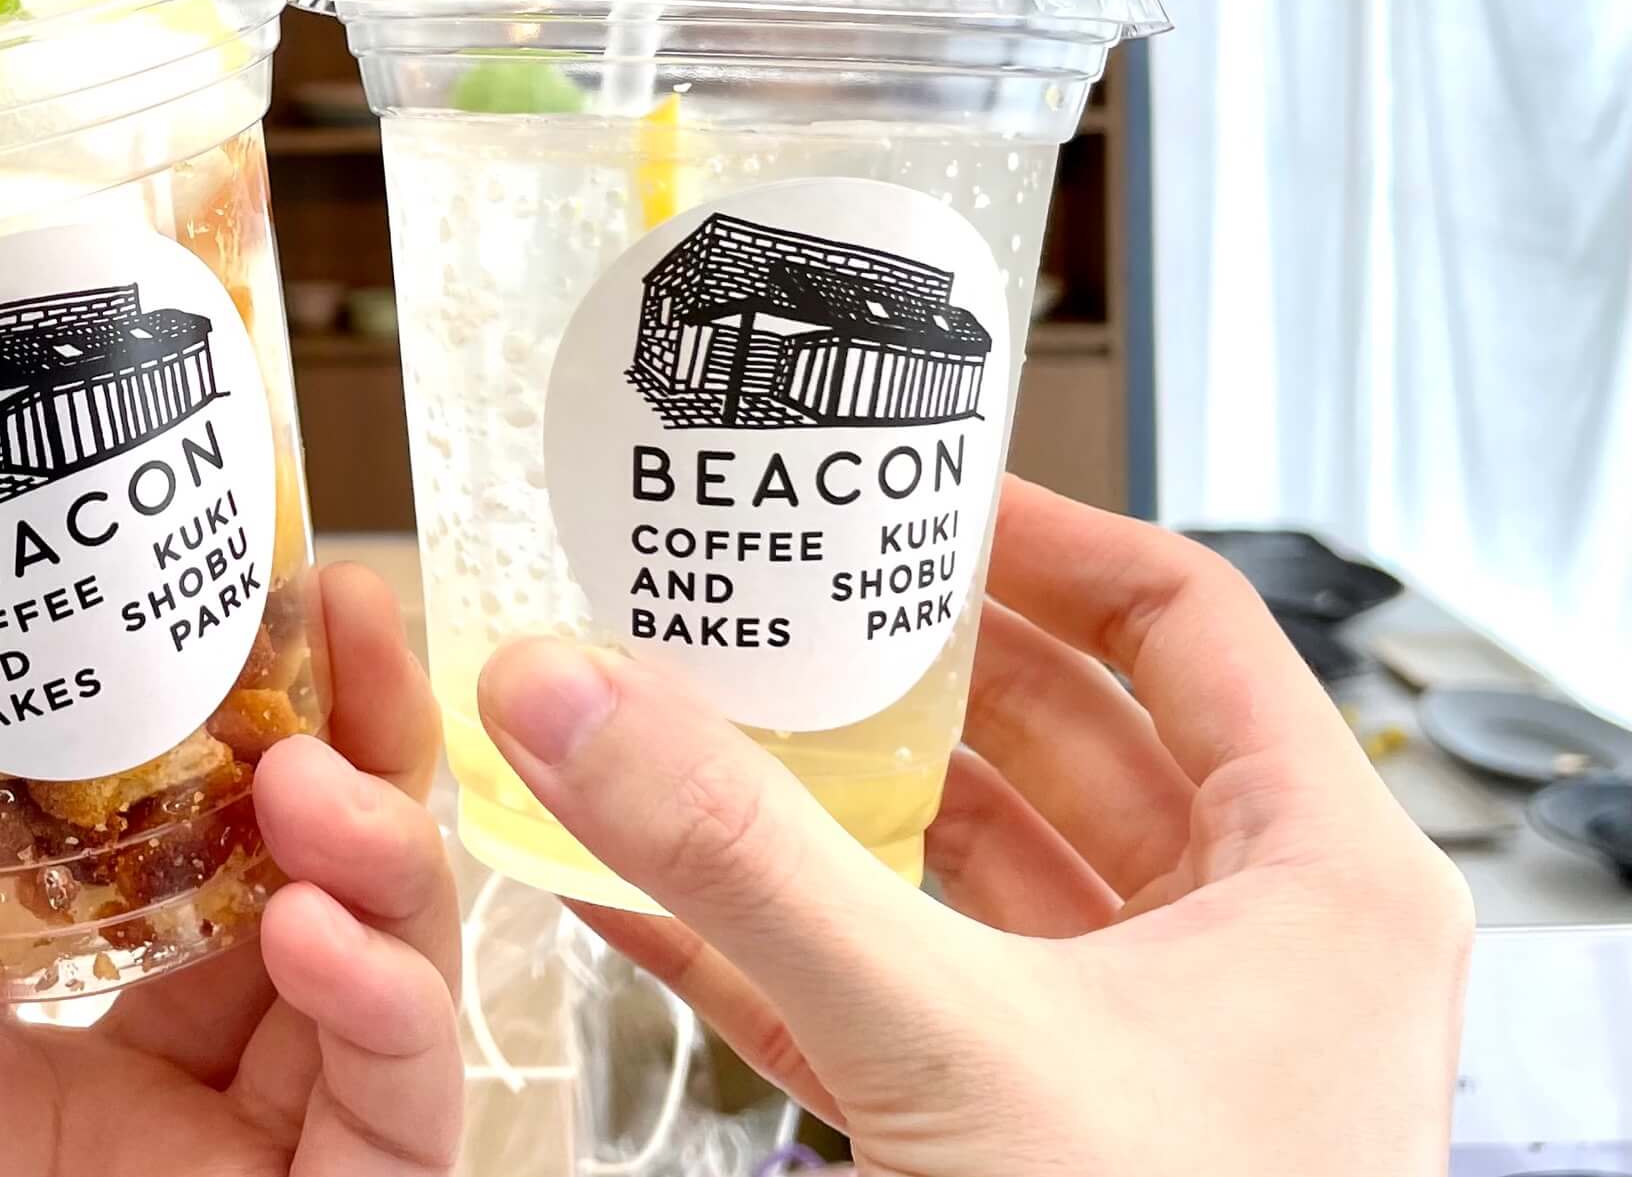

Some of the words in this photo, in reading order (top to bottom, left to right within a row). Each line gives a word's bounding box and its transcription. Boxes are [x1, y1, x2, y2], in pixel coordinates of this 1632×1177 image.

[632, 434, 964, 508] BEACON
[153, 489, 238, 571] KUKI
[631, 524, 824, 562] COFFEE
[881, 510, 958, 555] KUKI
[121, 526, 247, 632] SHOBU
[630, 566, 734, 604] AND
[831, 551, 955, 602] SHOBU
[169, 562, 261, 652] PARK
[631, 607, 791, 648] BAKES
[867, 591, 953, 641] PARK
